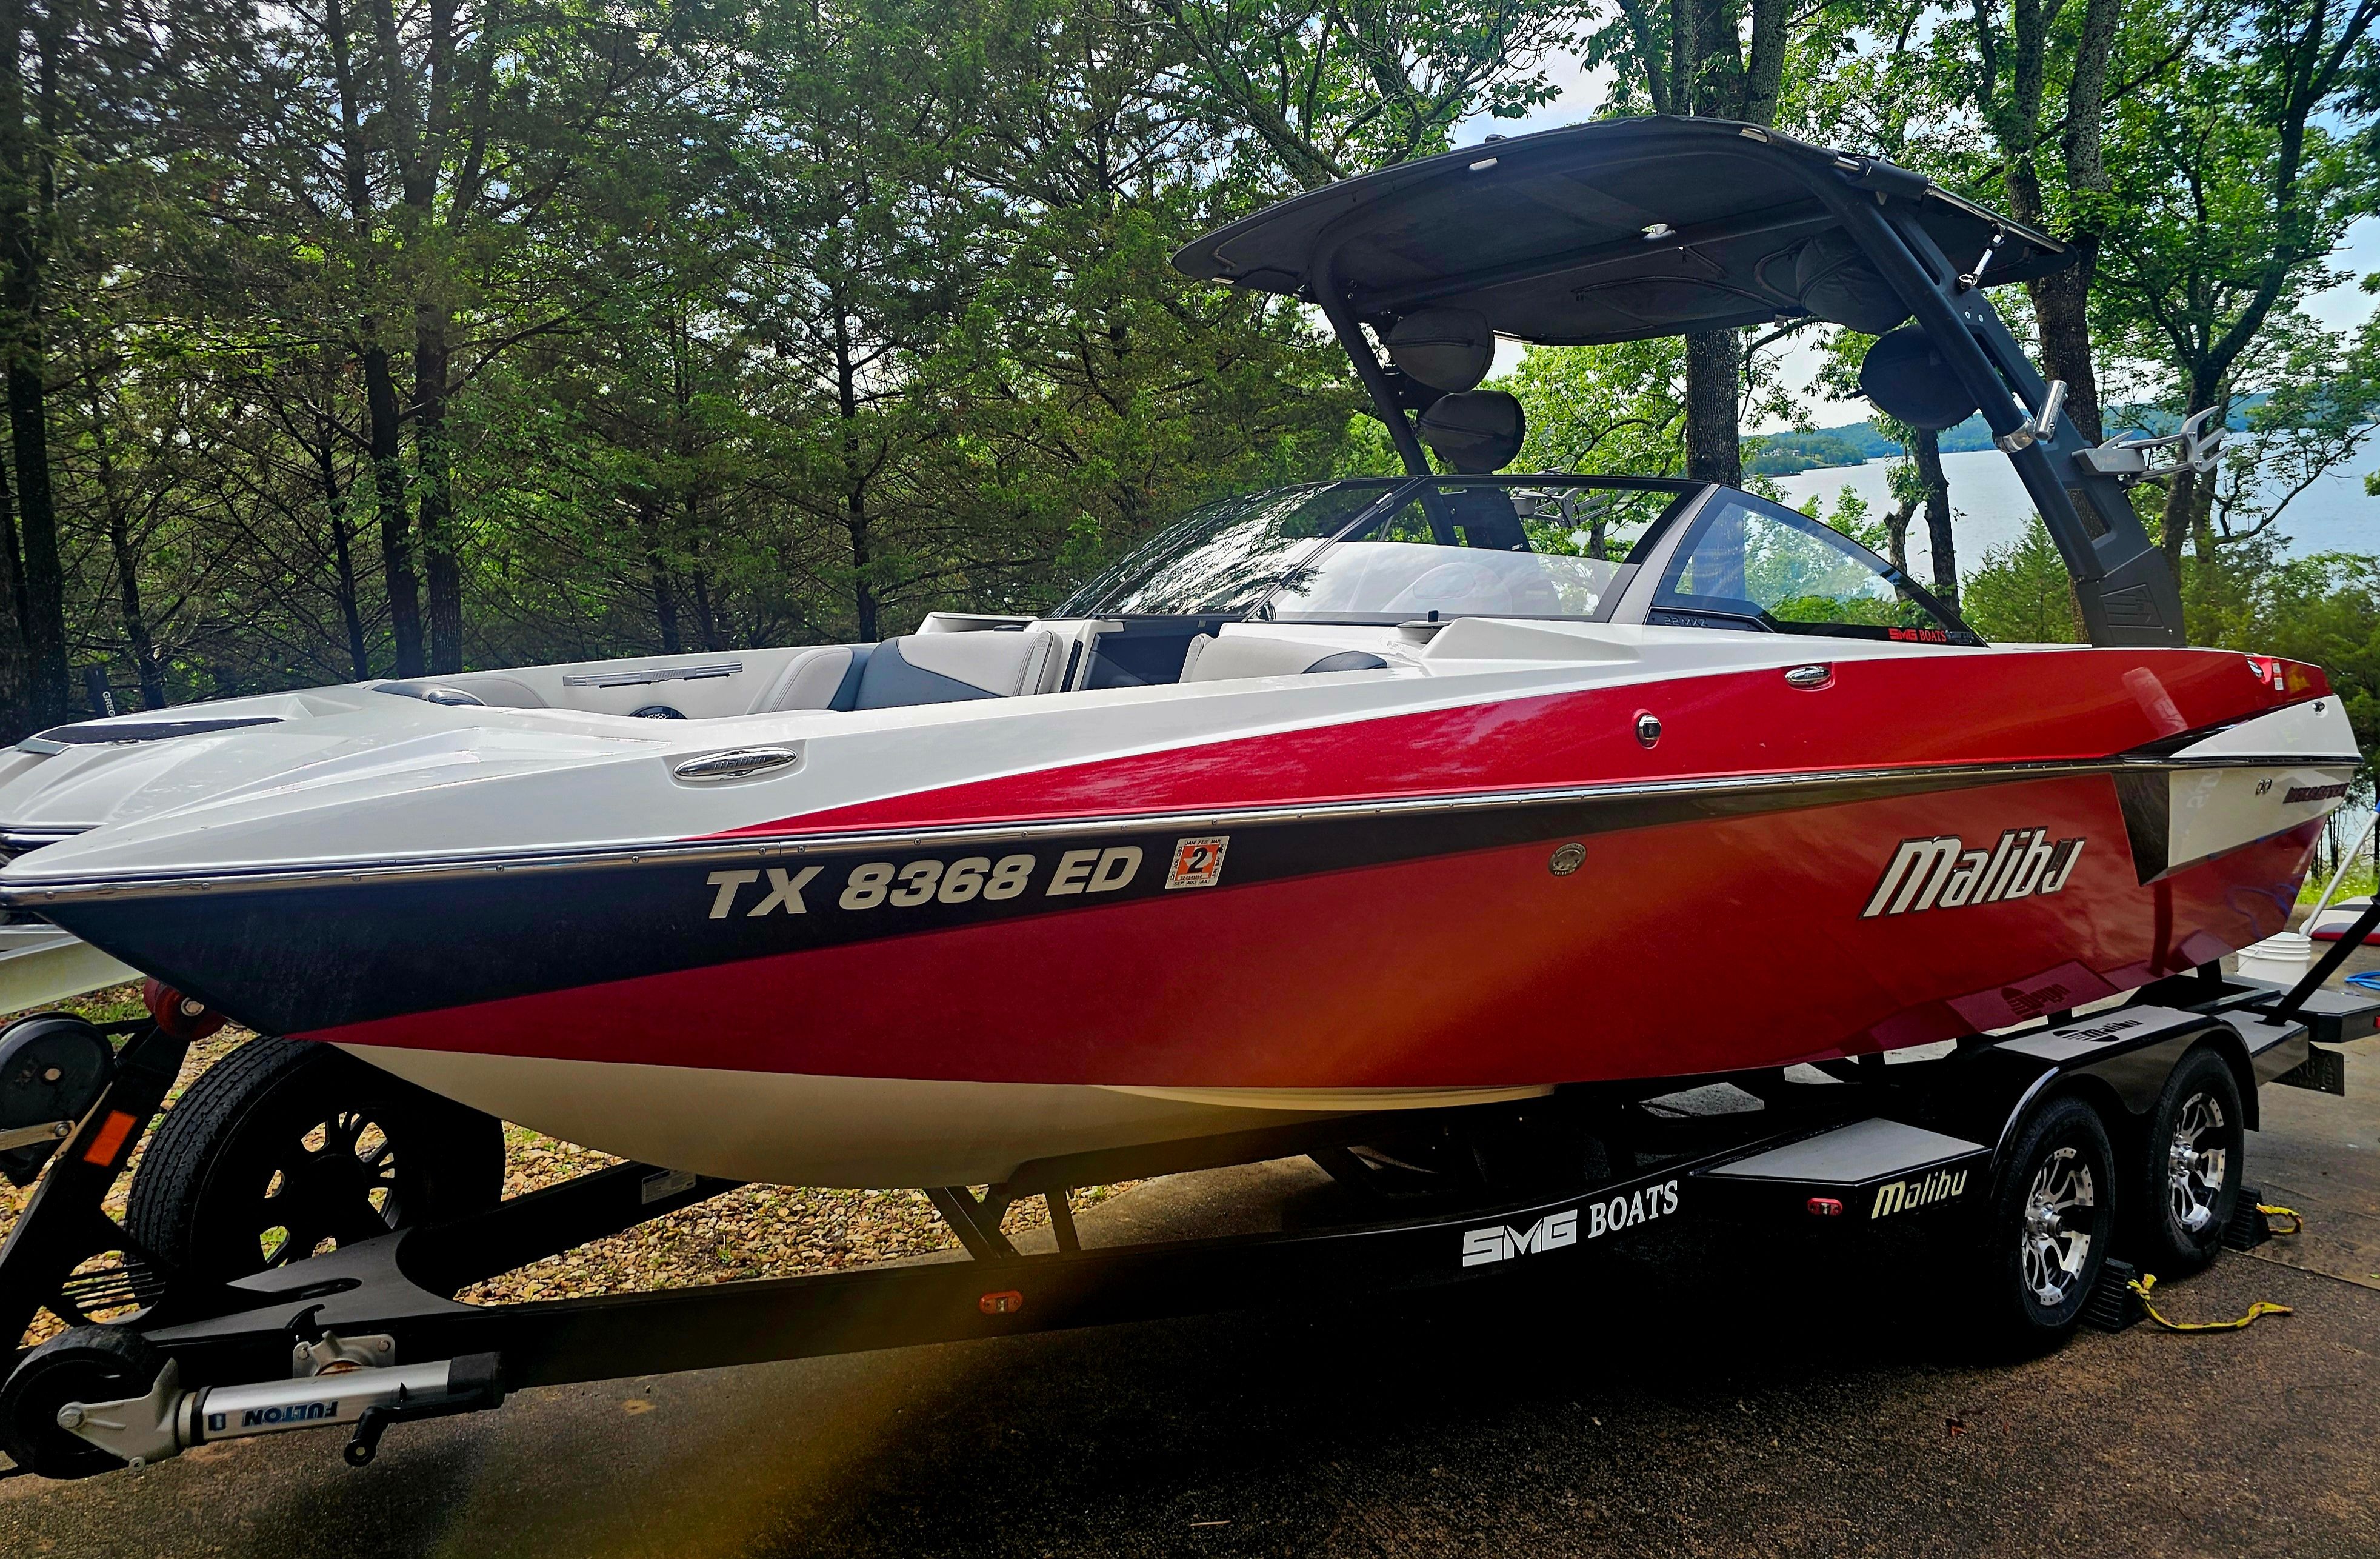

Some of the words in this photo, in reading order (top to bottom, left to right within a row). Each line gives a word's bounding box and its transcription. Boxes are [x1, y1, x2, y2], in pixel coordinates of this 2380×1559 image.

[1888, 627, 1918, 641] SMG
[1919, 629, 1947, 643] BOATS
[1187, 847, 1208, 873] 2
[706, 865, 824, 919] TX
[839, 855, 1036, 910] 8368
[1045, 846, 1143, 896] ED
[1871, 1169, 1967, 1219] Malibu
[1462, 1209, 1578, 1267] SMG
[1588, 1180, 1678, 1238] BOATS
[241, 1400, 339, 1427] FULTON
